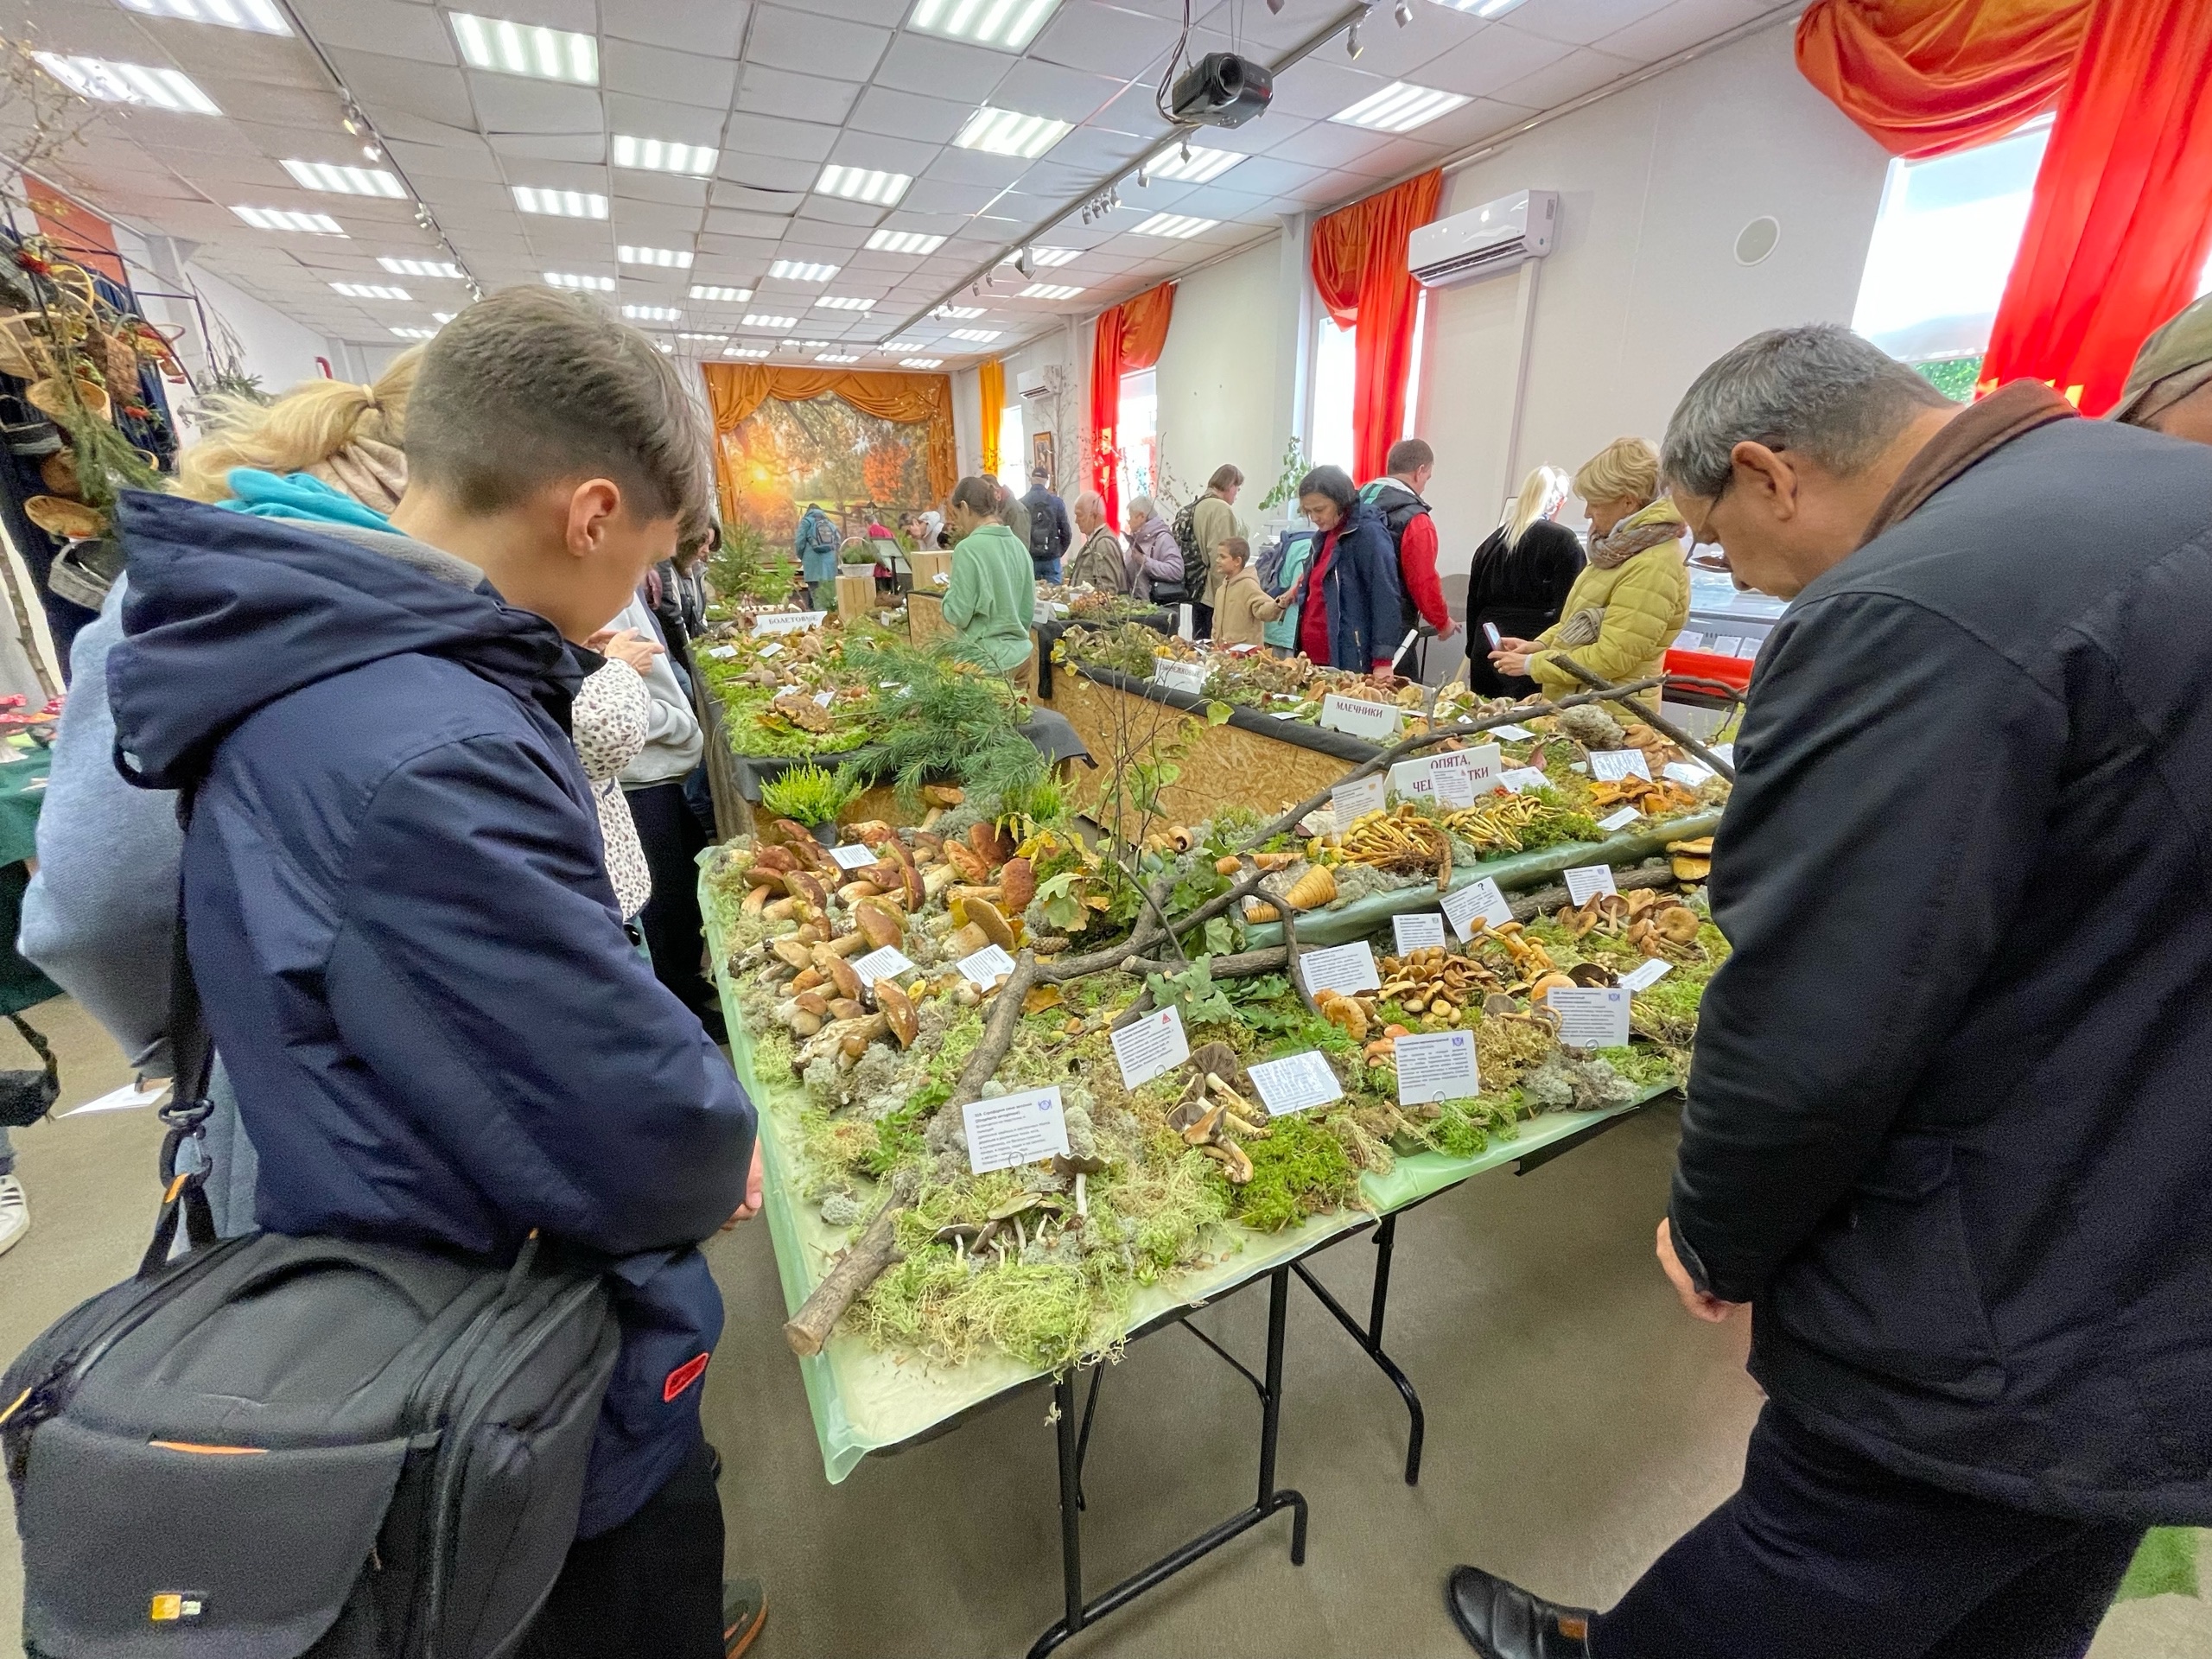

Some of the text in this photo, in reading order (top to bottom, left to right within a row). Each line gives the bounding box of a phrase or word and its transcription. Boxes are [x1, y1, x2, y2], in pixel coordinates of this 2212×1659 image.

[1336, 701, 1383, 718] МЛЕЧНИКИ
[1430, 754, 1471, 769] ОПЯТА,
[1413, 766, 1489, 792] ЧЕТКИ
[1478, 882, 1484, 891] ?
